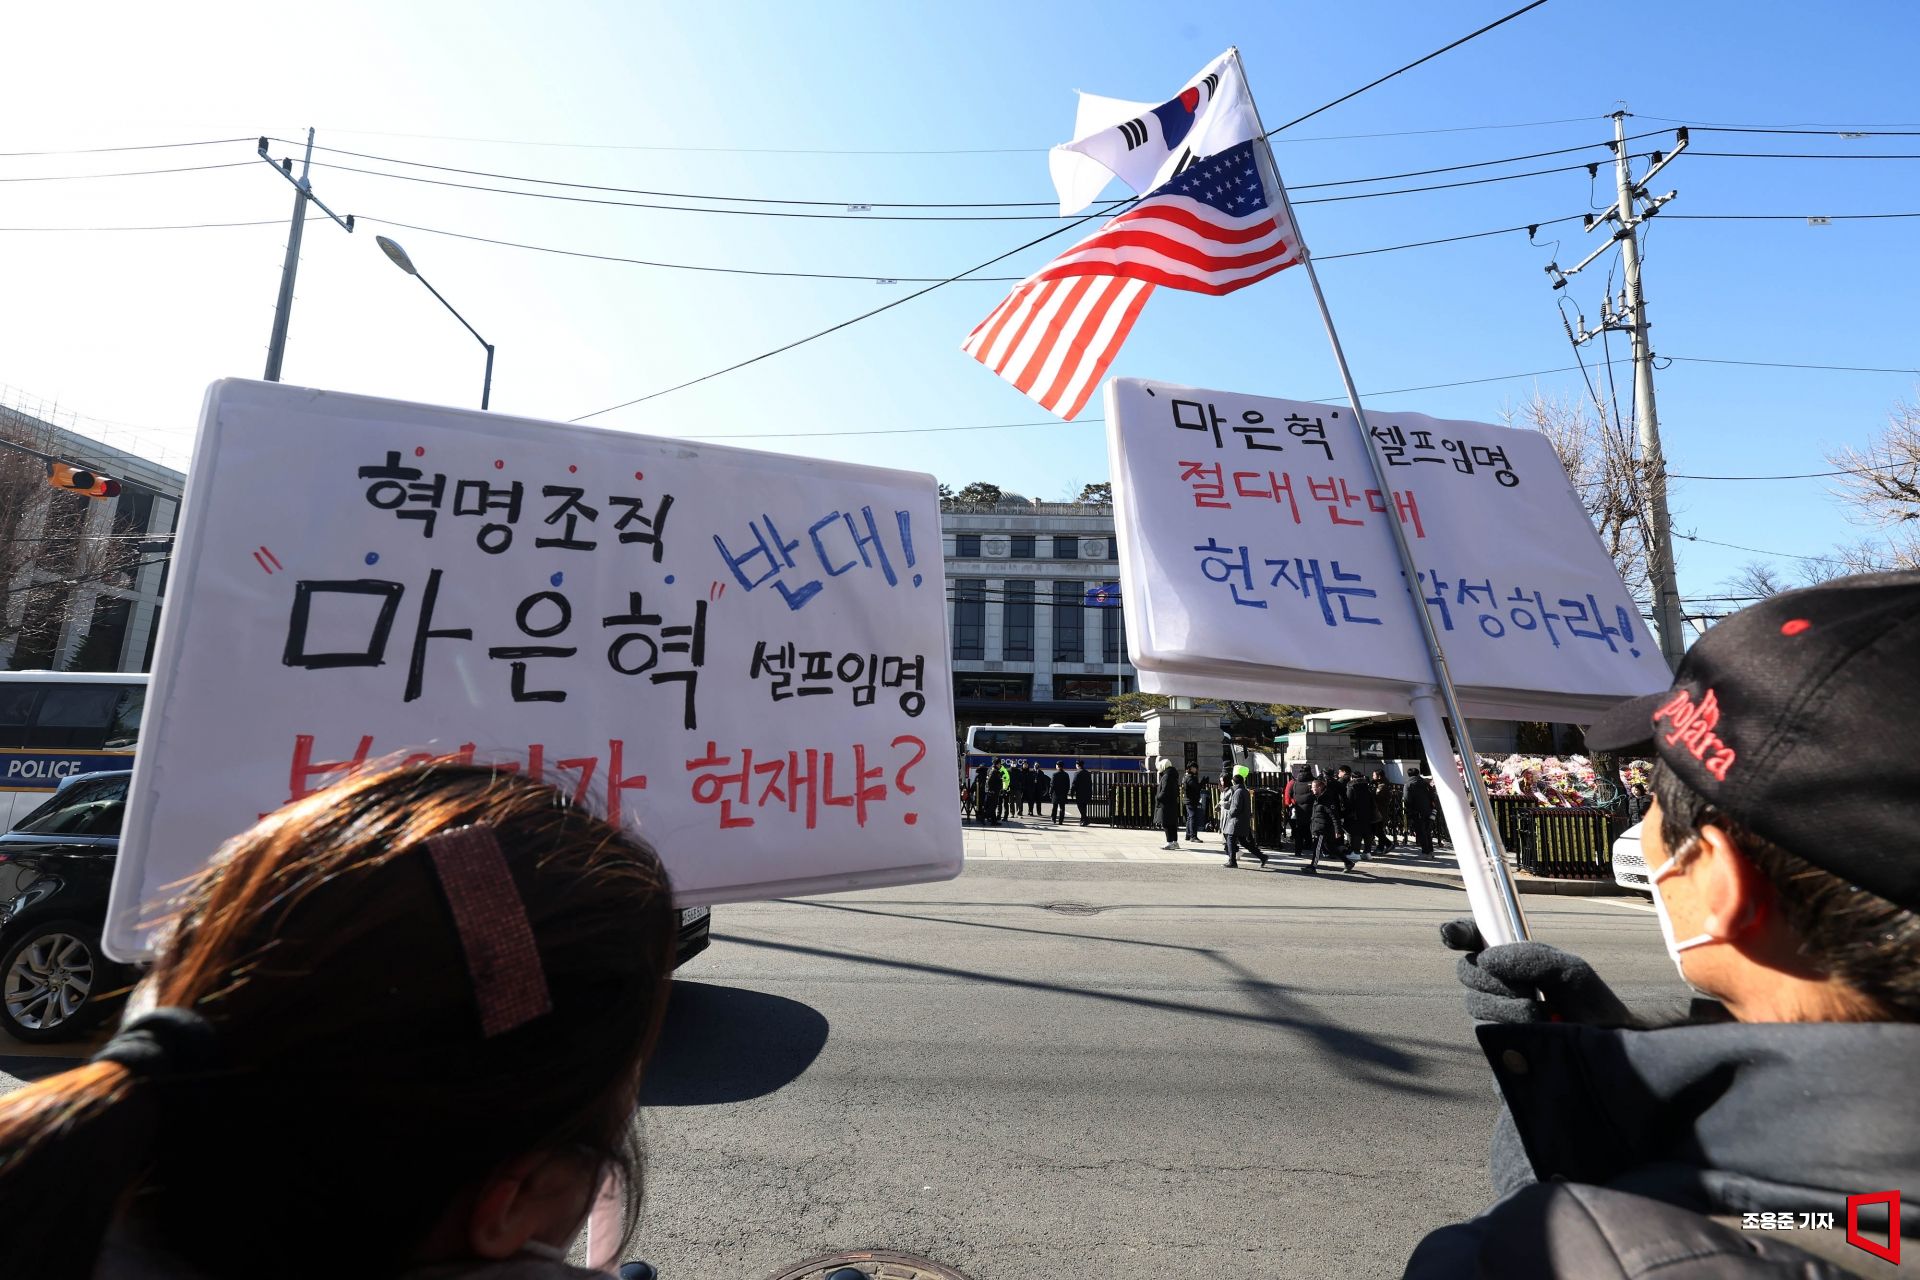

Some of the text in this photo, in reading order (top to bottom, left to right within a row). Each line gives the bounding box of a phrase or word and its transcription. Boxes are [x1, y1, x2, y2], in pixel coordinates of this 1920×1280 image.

[1371, 426, 1520, 488] 셀프임명
[713, 505, 924, 611] 반대!
[1193, 537, 1383, 627] 헌재는
[751, 641, 927, 718] 셀프임명
[8, 759, 81, 779] POLICE
[686, 735, 928, 831] 헌재냐?
